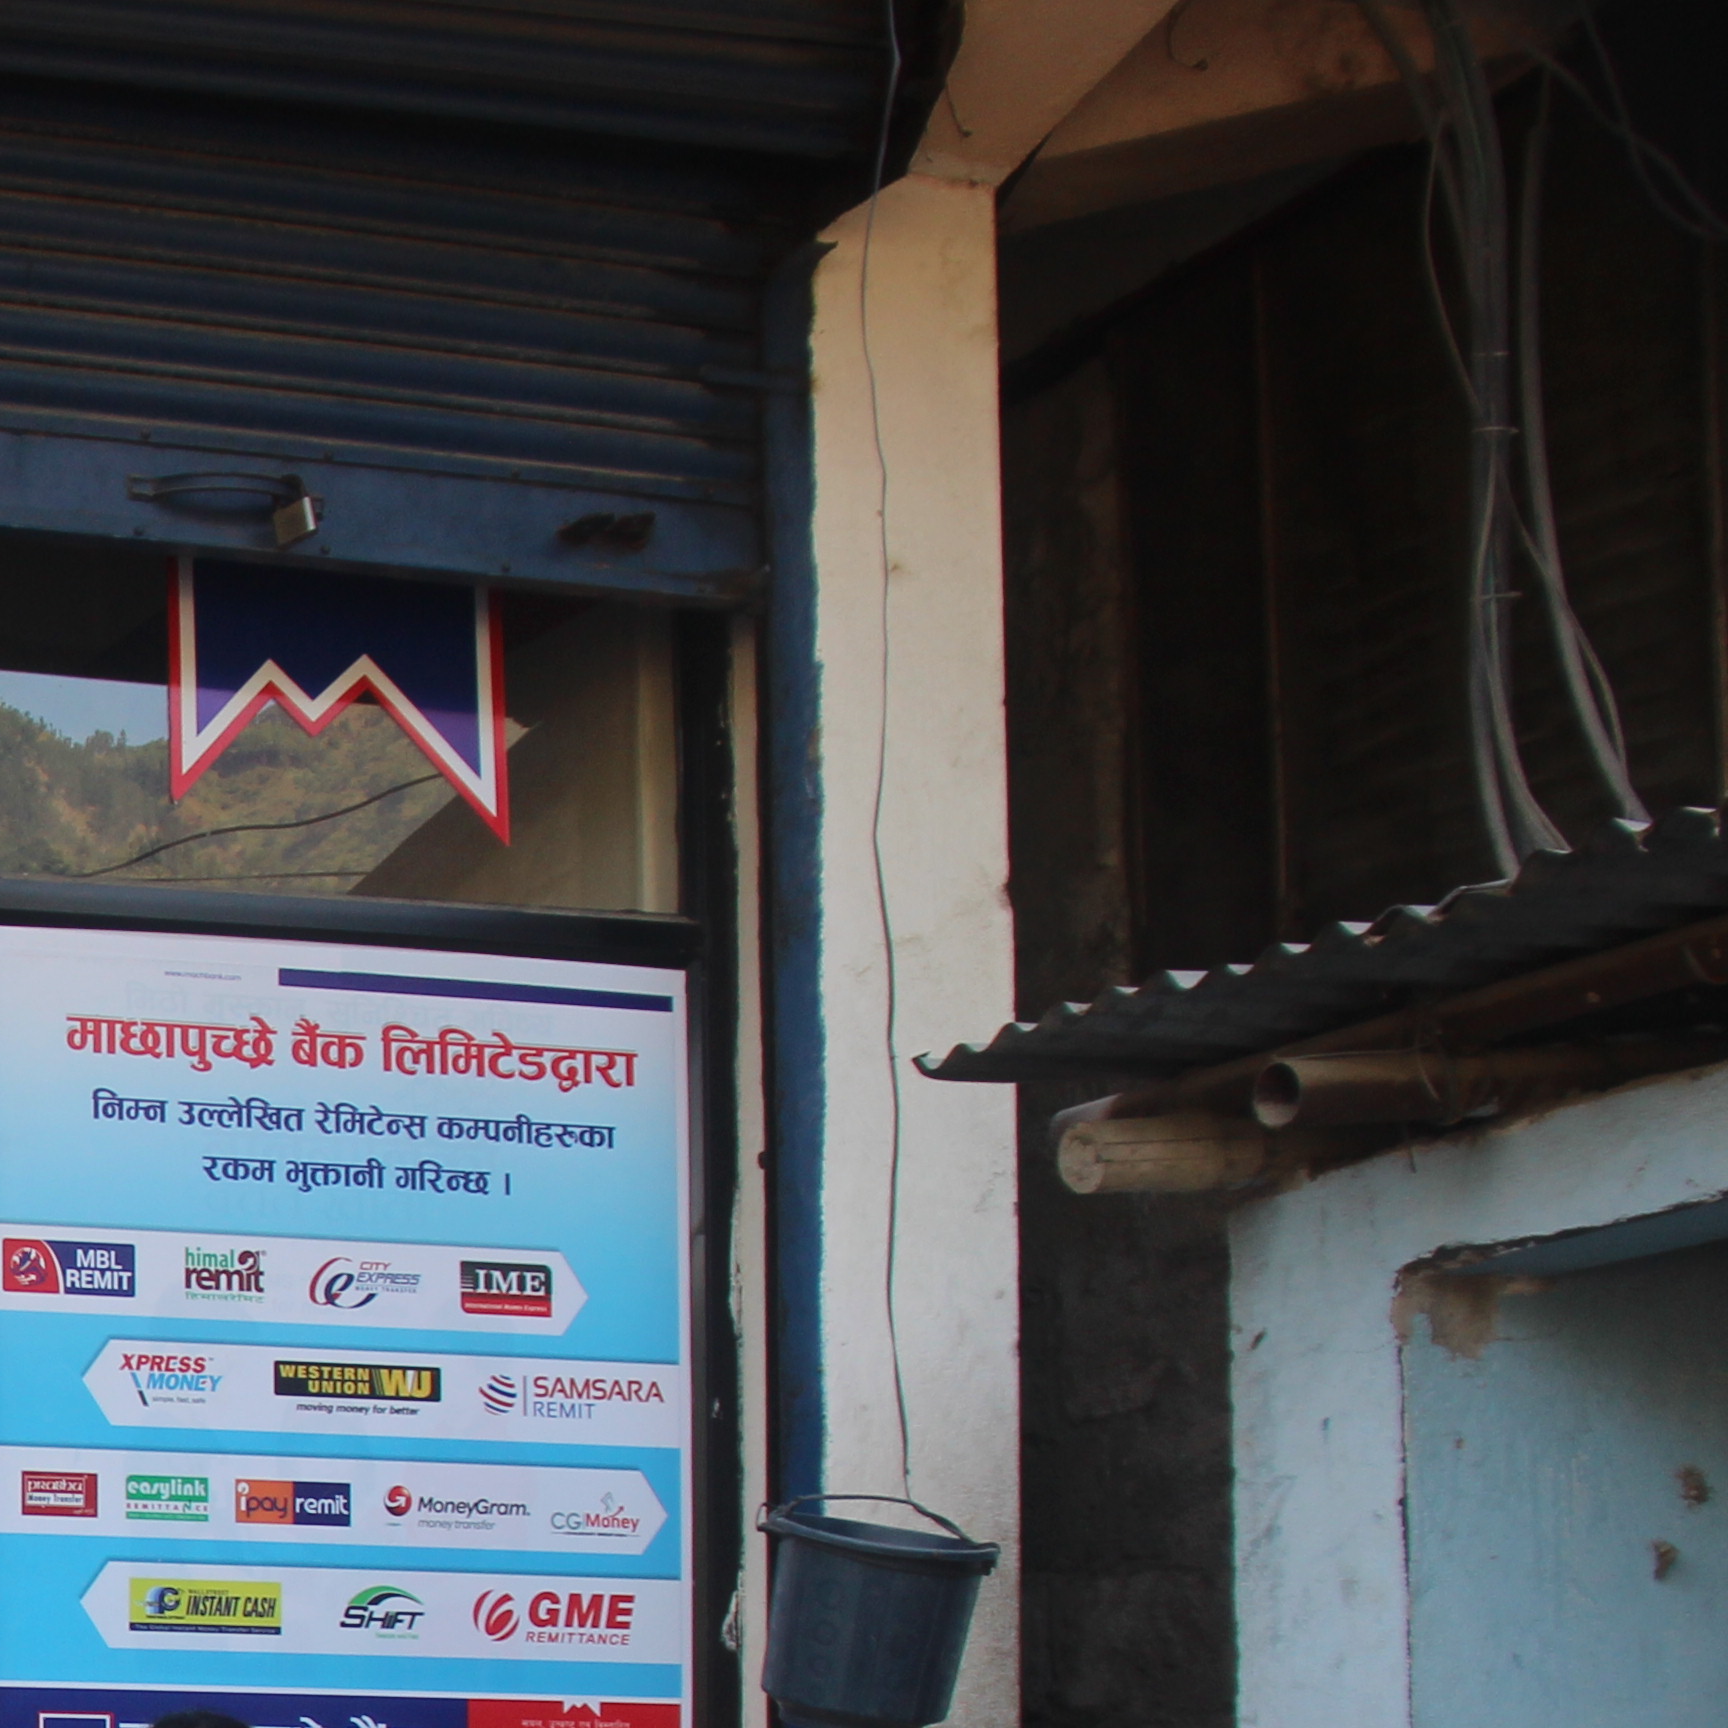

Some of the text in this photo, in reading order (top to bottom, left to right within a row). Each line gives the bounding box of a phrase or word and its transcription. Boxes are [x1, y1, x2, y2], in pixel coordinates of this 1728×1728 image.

[66, 1015, 638, 1093] माछापुच्छ्रे बैंक लिमिटेडद्वारा
[92, 1087, 169, 1123] निम्न
[178, 1095, 305, 1133] उल्लेखित
[314, 1101, 428, 1140] रेमिटेन्स
[202, 1156, 276, 1183] रकम
[285, 1157, 386, 1193] भुक्तानी
[395, 1160, 492, 1195] गरिन्छ
[76, 1248, 123, 1270] MBL
[185, 1247, 234, 1268] himal
[359, 1261, 391, 1271] CITY
[65, 1268, 132, 1291] REMIT
[184, 1256, 264, 1293] remit
[356, 1272, 421, 1285] EXPRESS
[475, 1269, 545, 1296] IME
[119, 1354, 206, 1373] XPRESS
[279, 1364, 370, 1381] WESTERN
[146, 1372, 223, 1392] MONEY
[308, 1380, 370, 1394] UNION
[533, 1376, 665, 1403] SAMSARA
[296, 1402, 420, 1416] moving money for better
[533, 1401, 595, 1419] REMIT
[128, 1479, 206, 1499] easylink
[126, 1500, 208, 1512] REMITTANCE
[296, 1495, 349, 1515] remit
[418, 1519, 495, 1530] money transfer
[551, 1512, 640, 1532] CG Money
[186, 1596, 277, 1617] INSTANT CASH
[528, 1591, 636, 1630] GME
[525, 1632, 630, 1645] REMITTANCE
